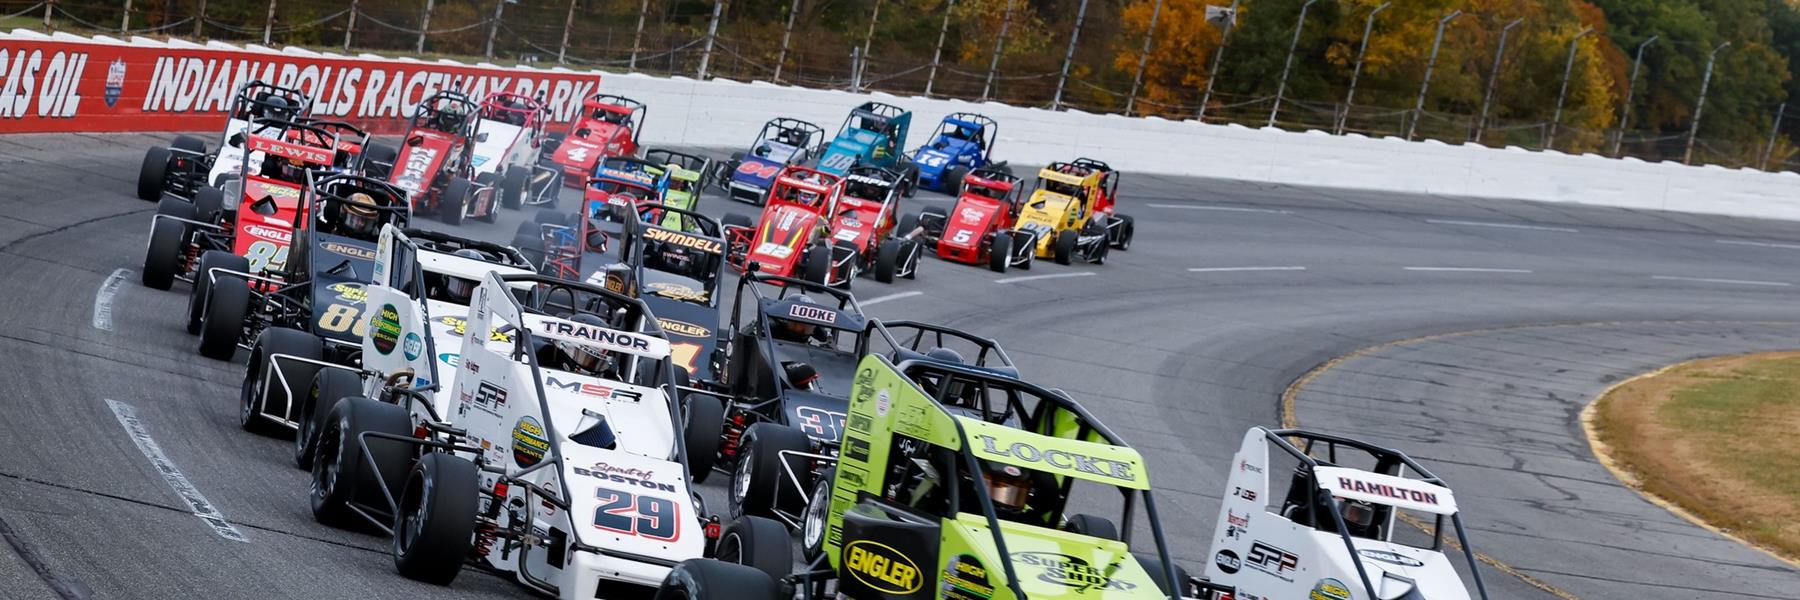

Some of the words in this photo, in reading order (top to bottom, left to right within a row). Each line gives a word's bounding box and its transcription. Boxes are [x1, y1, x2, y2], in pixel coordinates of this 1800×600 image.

[38, 51, 88, 118] OIL
[142, 56, 363, 117] INDIANAPOLIS
[357, 69, 511, 119] RACEWAY
[512, 78, 595, 122] PARK
[255, 141, 327, 161] LEWIS
[249, 225, 293, 241] ENGLE
[642, 227, 722, 254] SWINDELL
[953, 230, 973, 243] 5
[326, 243, 376, 260] ENGLE
[541, 320, 650, 350] TRAINOR
[657, 319, 705, 337] NGLER
[546, 377, 642, 402] MSR
[978, 434, 1135, 482] LOCKE
[573, 467, 676, 493] BOSTON
[1338, 477, 1439, 505] HAMILTON
[592, 487, 681, 543] 29
[848, 545, 916, 590] ENGLER
[1020, 554, 1100, 576] SUPER
